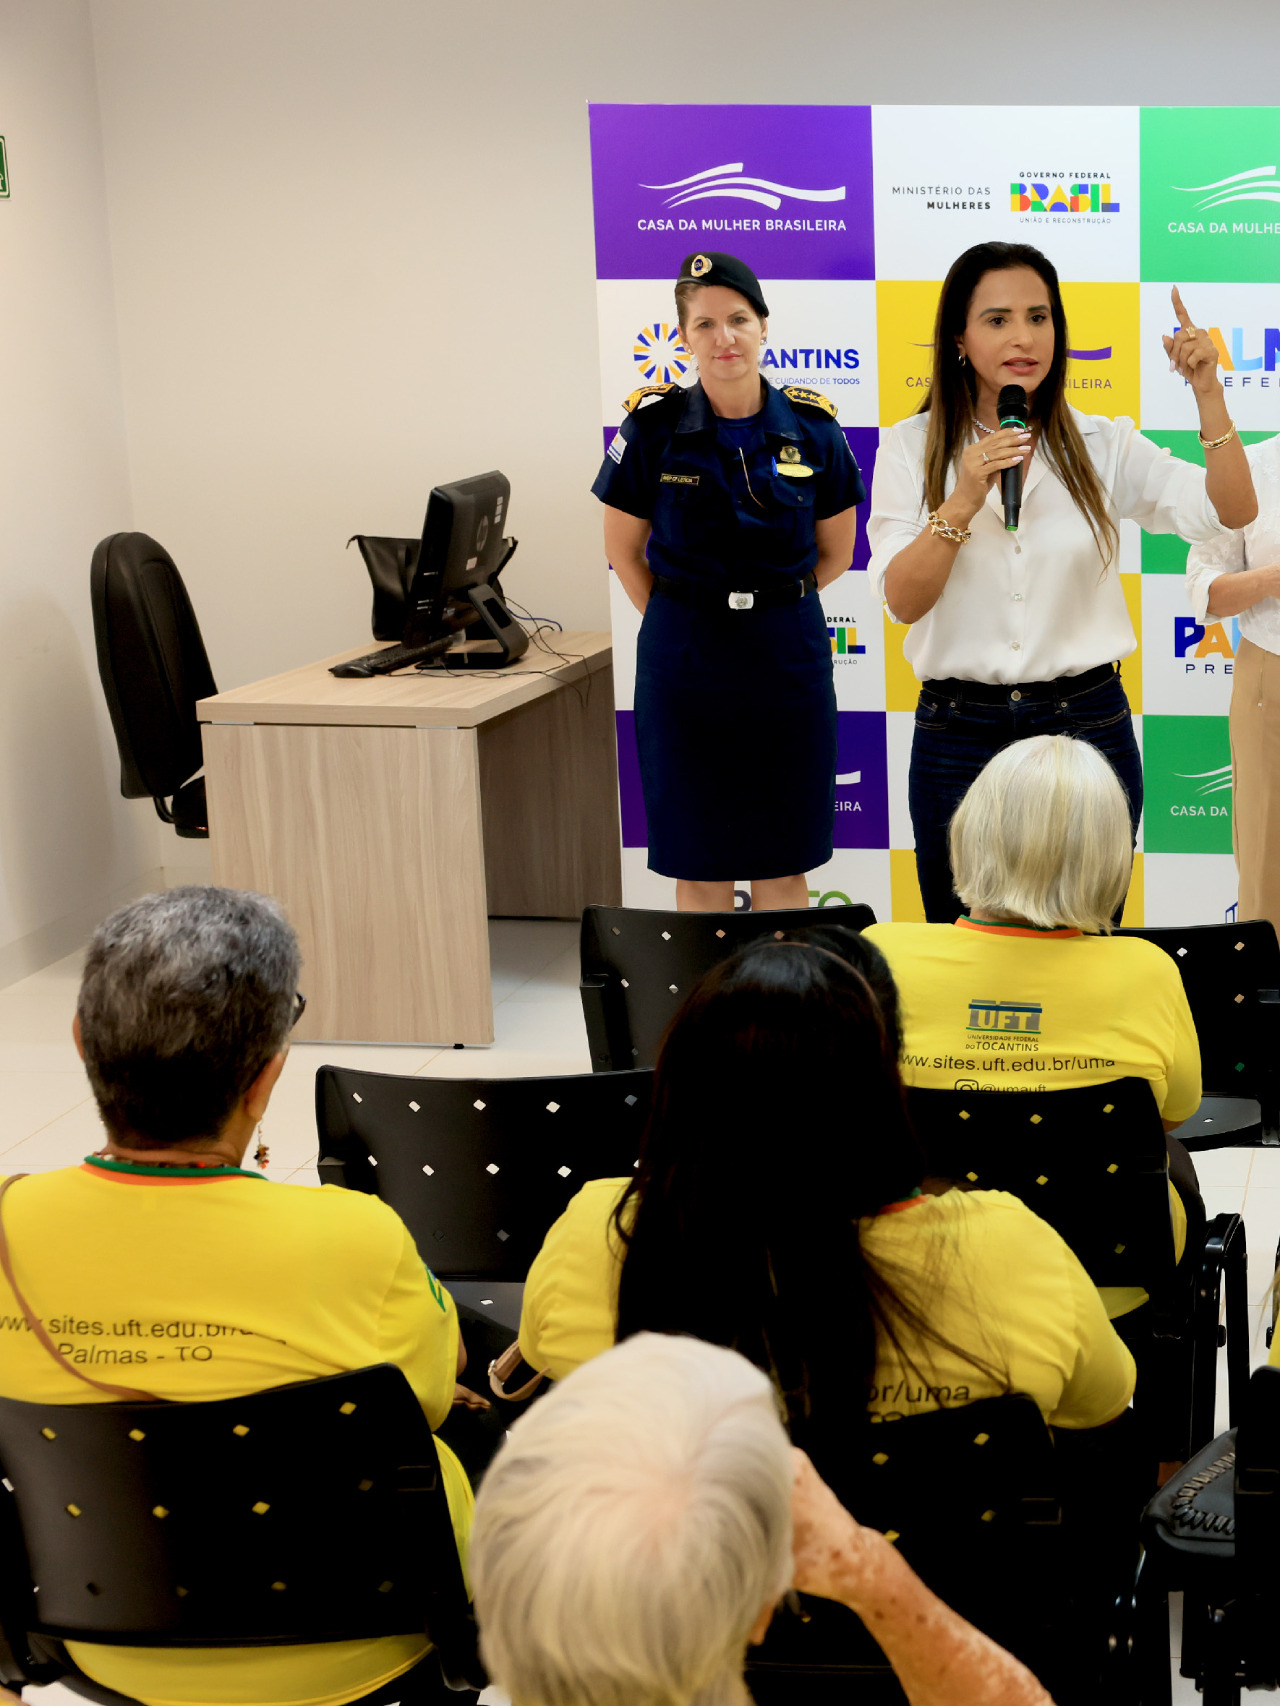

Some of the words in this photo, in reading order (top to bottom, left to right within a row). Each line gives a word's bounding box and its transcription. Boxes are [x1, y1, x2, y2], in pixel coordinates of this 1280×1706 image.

[892, 184, 963, 196] MINISTÉRIO
[968, 186, 991, 196] DAS
[1010, 183, 1120, 213] BRASIL
[926, 201, 991, 210] MULHERES
[637, 219, 675, 231] CASA
[678, 219, 698, 231] DA
[701, 219, 761, 231] MULHER
[765, 219, 847, 231] BRASILEIRA
[1019, 216, 1043, 224] UNIÃO
[1052, 217, 1112, 225] RECONSTRUÇÃO
[1167, 222, 1205, 234] CASA
[1209, 222, 1229, 234] DA
[763, 348, 860, 369] ANTINS
[775, 377, 817, 385] CUIDANDO
[819, 377, 831, 385] DE
[832, 377, 860, 385] TODOS
[905, 377, 932, 388] CAS
[1063, 377, 1113, 389] ILEIRA
[1170, 805, 1206, 816] CASA
[1210, 806, 1228, 817] DA
[976, 1041, 1040, 1052] TOCANTINS
[902, 1053, 1116, 1072] ww.sites.uft.edu.br/uma
[57, 1343, 148, 1364] Palmas
[175, 1345, 213, 1362] TO
